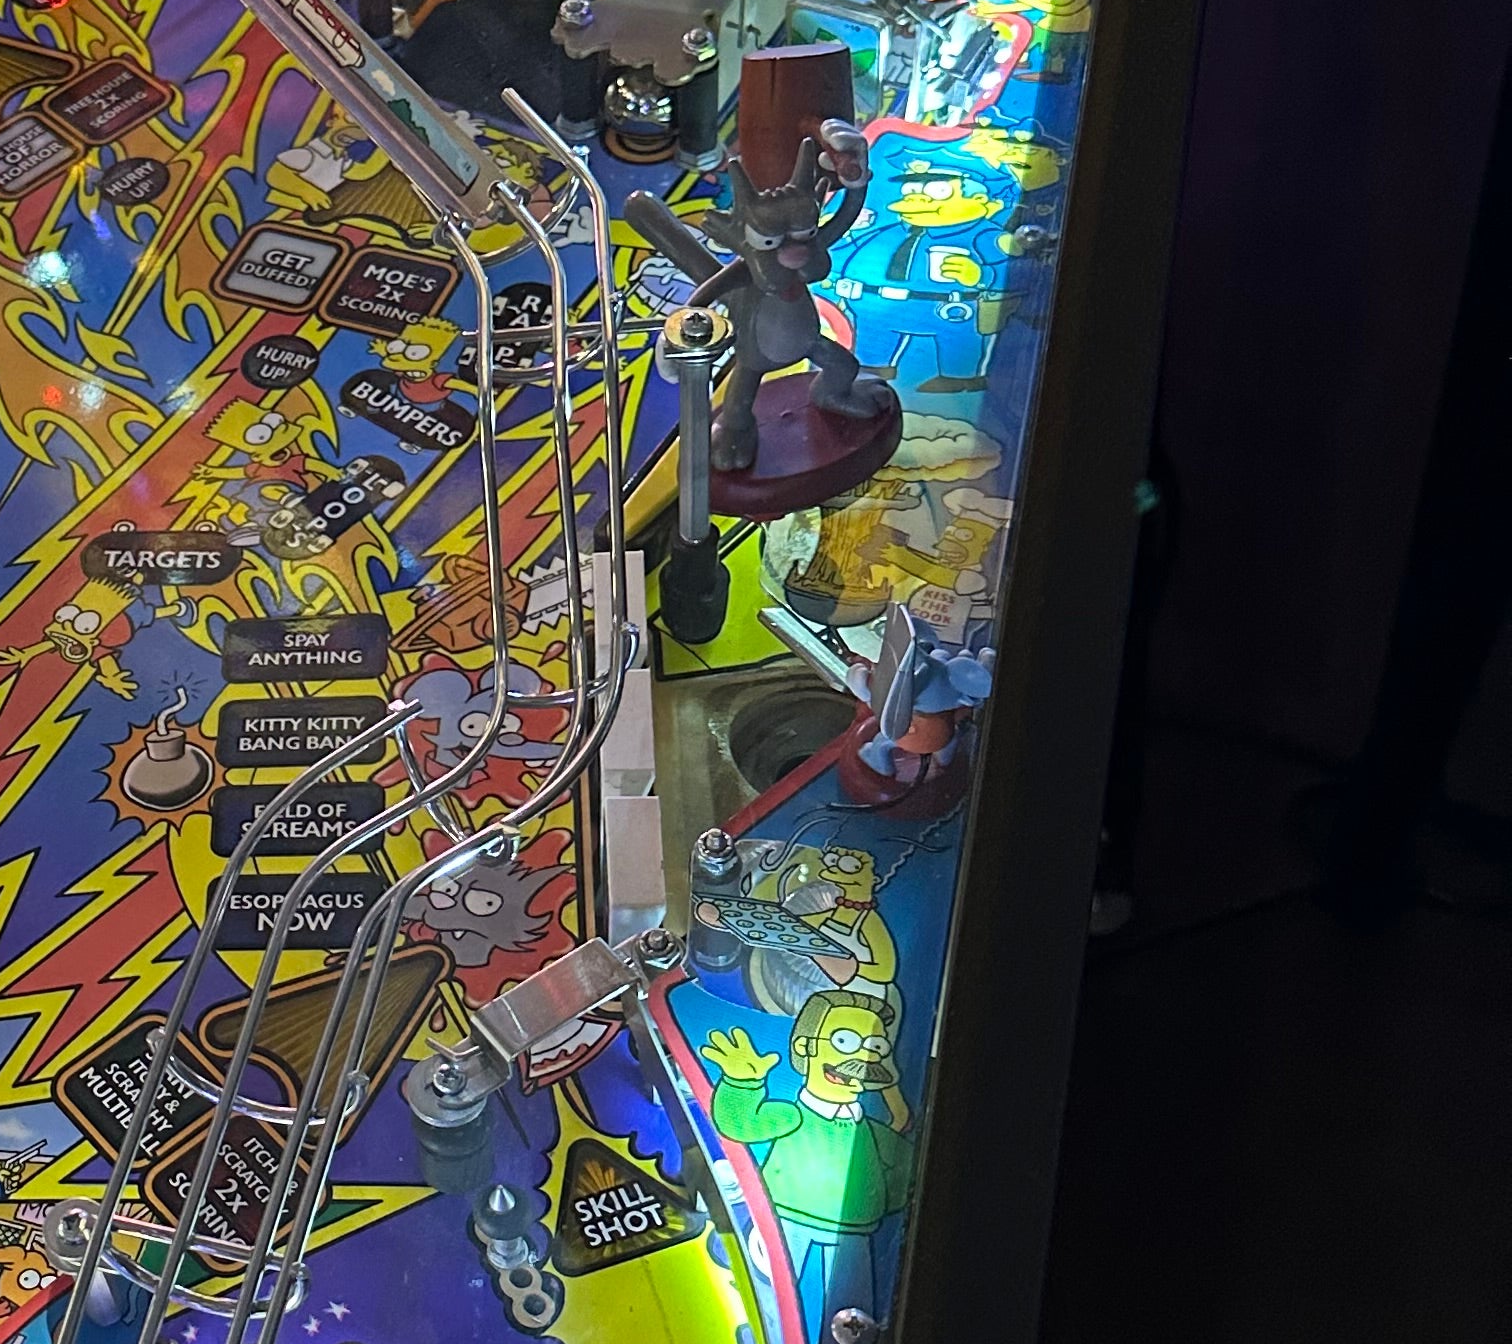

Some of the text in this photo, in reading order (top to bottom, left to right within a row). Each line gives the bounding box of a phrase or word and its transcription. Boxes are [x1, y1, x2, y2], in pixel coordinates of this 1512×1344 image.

[63, 70, 135, 117] TREE HOUSE
[88, 91, 148, 130] SCORING
[4, 125, 46, 154] HOUSE
[4, 142, 32, 166] OF
[104, 161, 157, 197] HURRY
[264, 249, 312, 272] GET
[239, 262, 317, 290] DUFFED!
[362, 263, 438, 294] MOE'S
[337, 295, 422, 325] SCORING
[255, 344, 317, 371] HURRY
[259, 363, 291, 381] UP!
[350, 381, 464, 448] BUMPERS
[104, 548, 222, 570] TARGETS
[920, 599, 950, 614] THE
[923, 589, 957, 606] KISS
[910, 607, 953, 625] COOK
[283, 632, 331, 648] SPAY
[247, 649, 363, 667] ANYTHING
[244, 716, 366, 733] KITTY KITTY
[238, 734, 354, 752] BANG BAN
[316, 803, 349, 818] OF
[228, 893, 365, 910] ESOPAGUS
[103, 1062, 174, 1133] SCRAHY
[127, 1058, 181, 1115] ITCY &
[78, 1065, 161, 1158] MULTIBLL
[243, 1136, 281, 1177] ITCH
[214, 1178, 250, 1216] 2X
[574, 1182, 656, 1225] SKILL
[582, 1202, 663, 1248] SHOT
